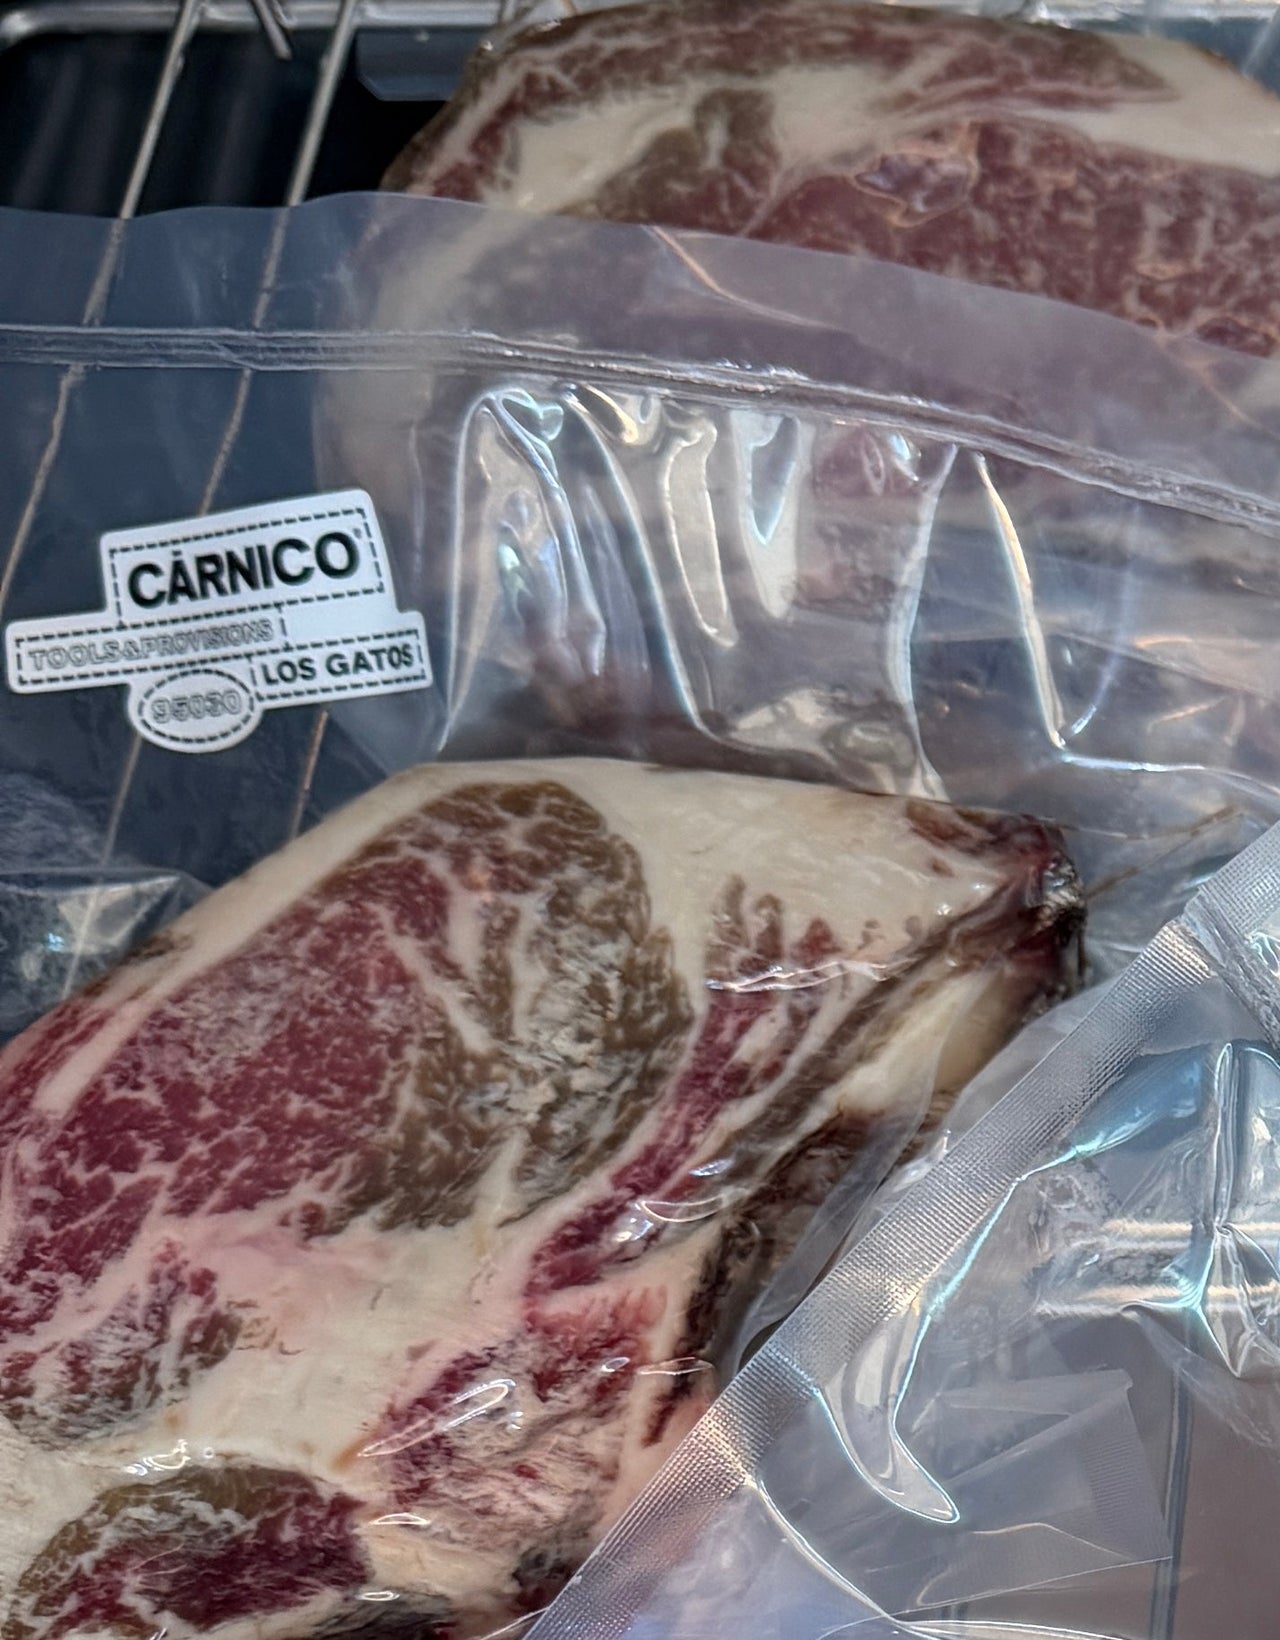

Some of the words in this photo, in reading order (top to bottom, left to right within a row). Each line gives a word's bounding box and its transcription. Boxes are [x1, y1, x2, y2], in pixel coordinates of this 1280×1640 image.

[262, 657, 317, 688] LOS
[326, 643, 414, 678] GATOS
[150, 688, 243, 724] 95030
